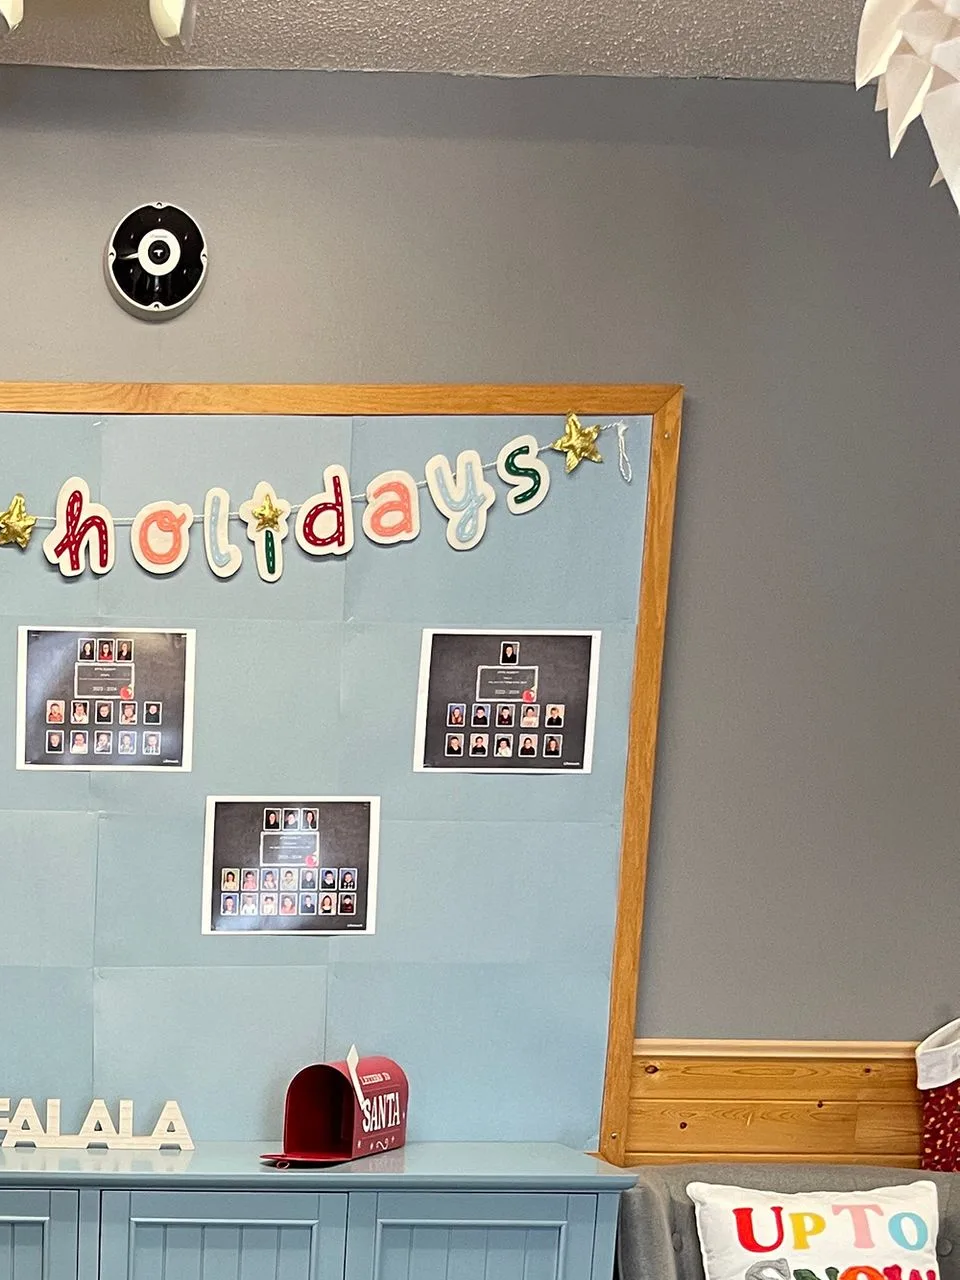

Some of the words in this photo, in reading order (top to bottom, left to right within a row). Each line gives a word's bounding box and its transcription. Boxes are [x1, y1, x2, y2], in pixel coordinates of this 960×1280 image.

[52, 443, 543, 576] holidays
[362, 1092, 401, 1133] SANTA
[731, 1206, 826, 1253] UP
[831, 1204, 929, 1251] TO
